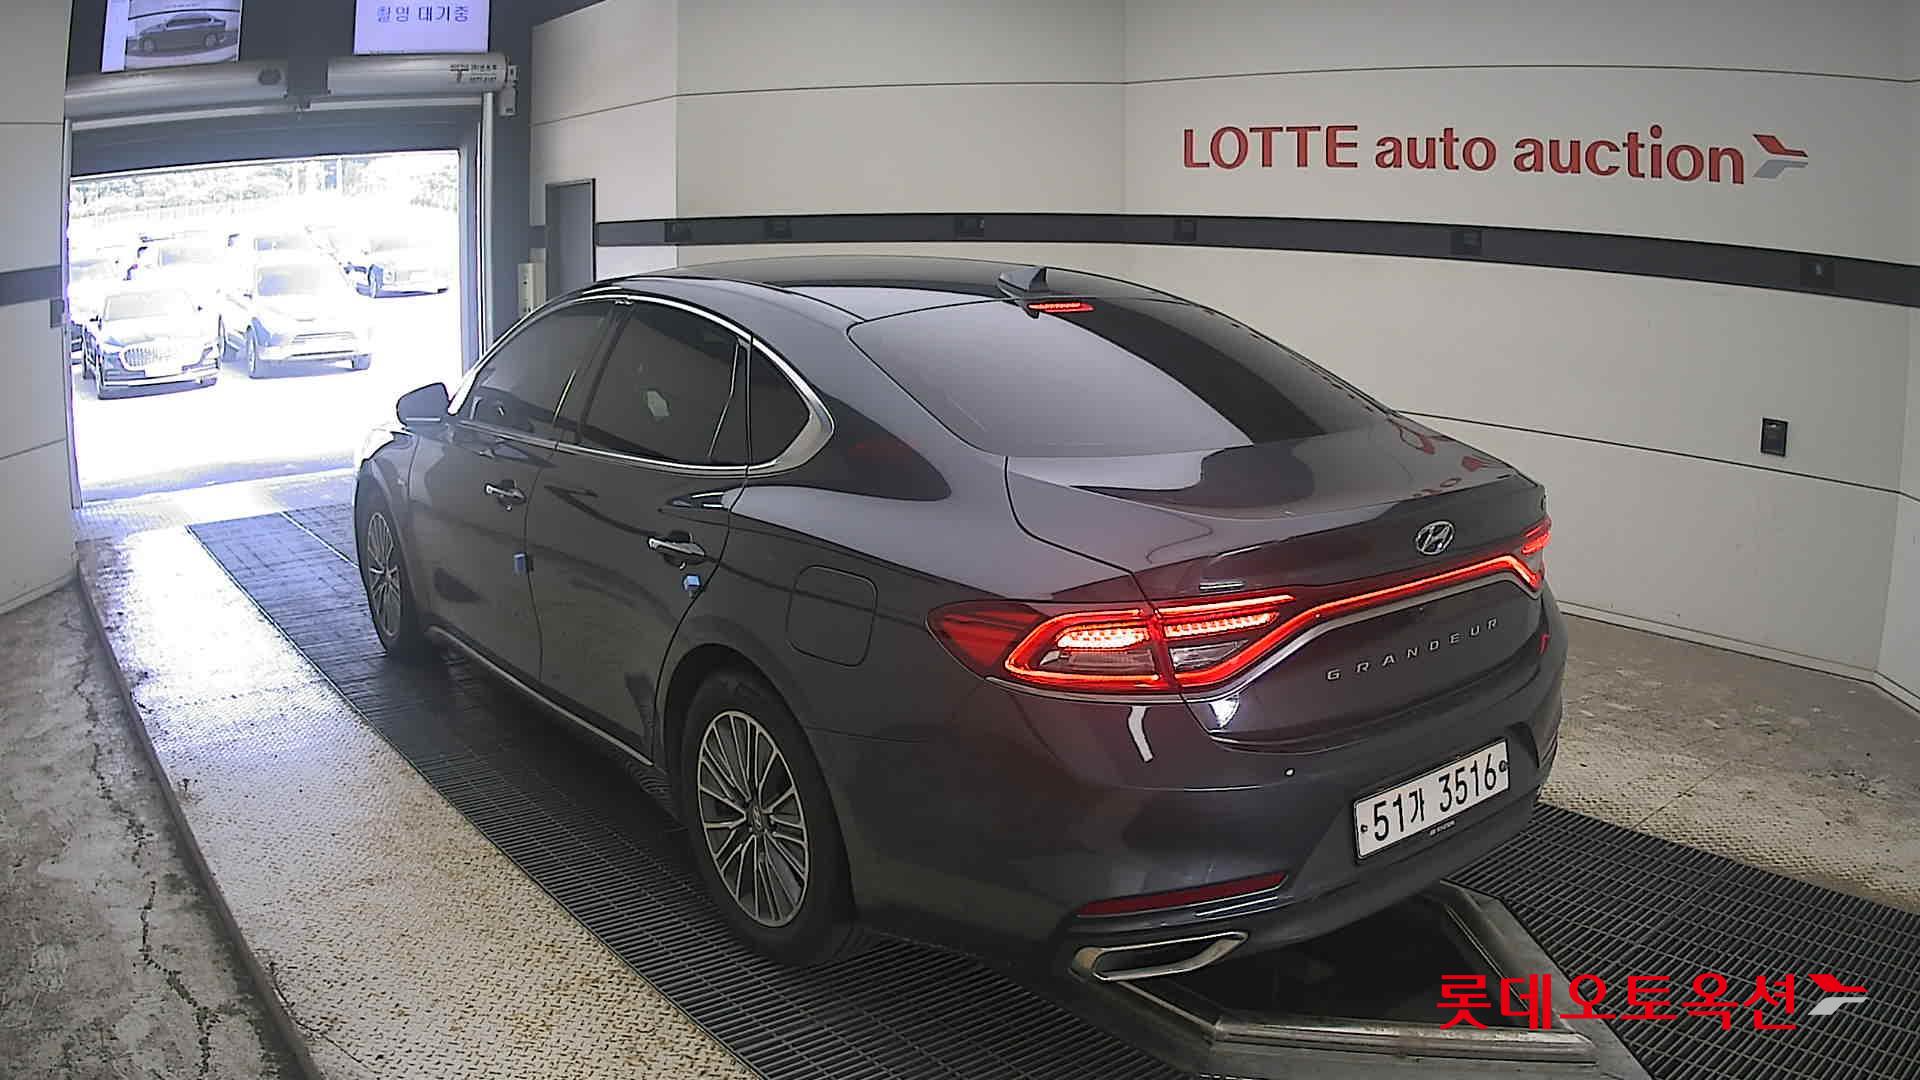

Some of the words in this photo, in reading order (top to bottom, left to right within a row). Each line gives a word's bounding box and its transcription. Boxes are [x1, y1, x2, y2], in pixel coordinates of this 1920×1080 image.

[418, 6, 469, 23] 대기중
[1183, 125, 1358, 169] LOTTE
[1375, 127, 1497, 171] auto
[1513, 125, 1745, 185] auction
[1327, 618, 1498, 681] GRANDEUR
[1373, 788, 1425, 842] 51가
[1438, 753, 1498, 813] 3516
